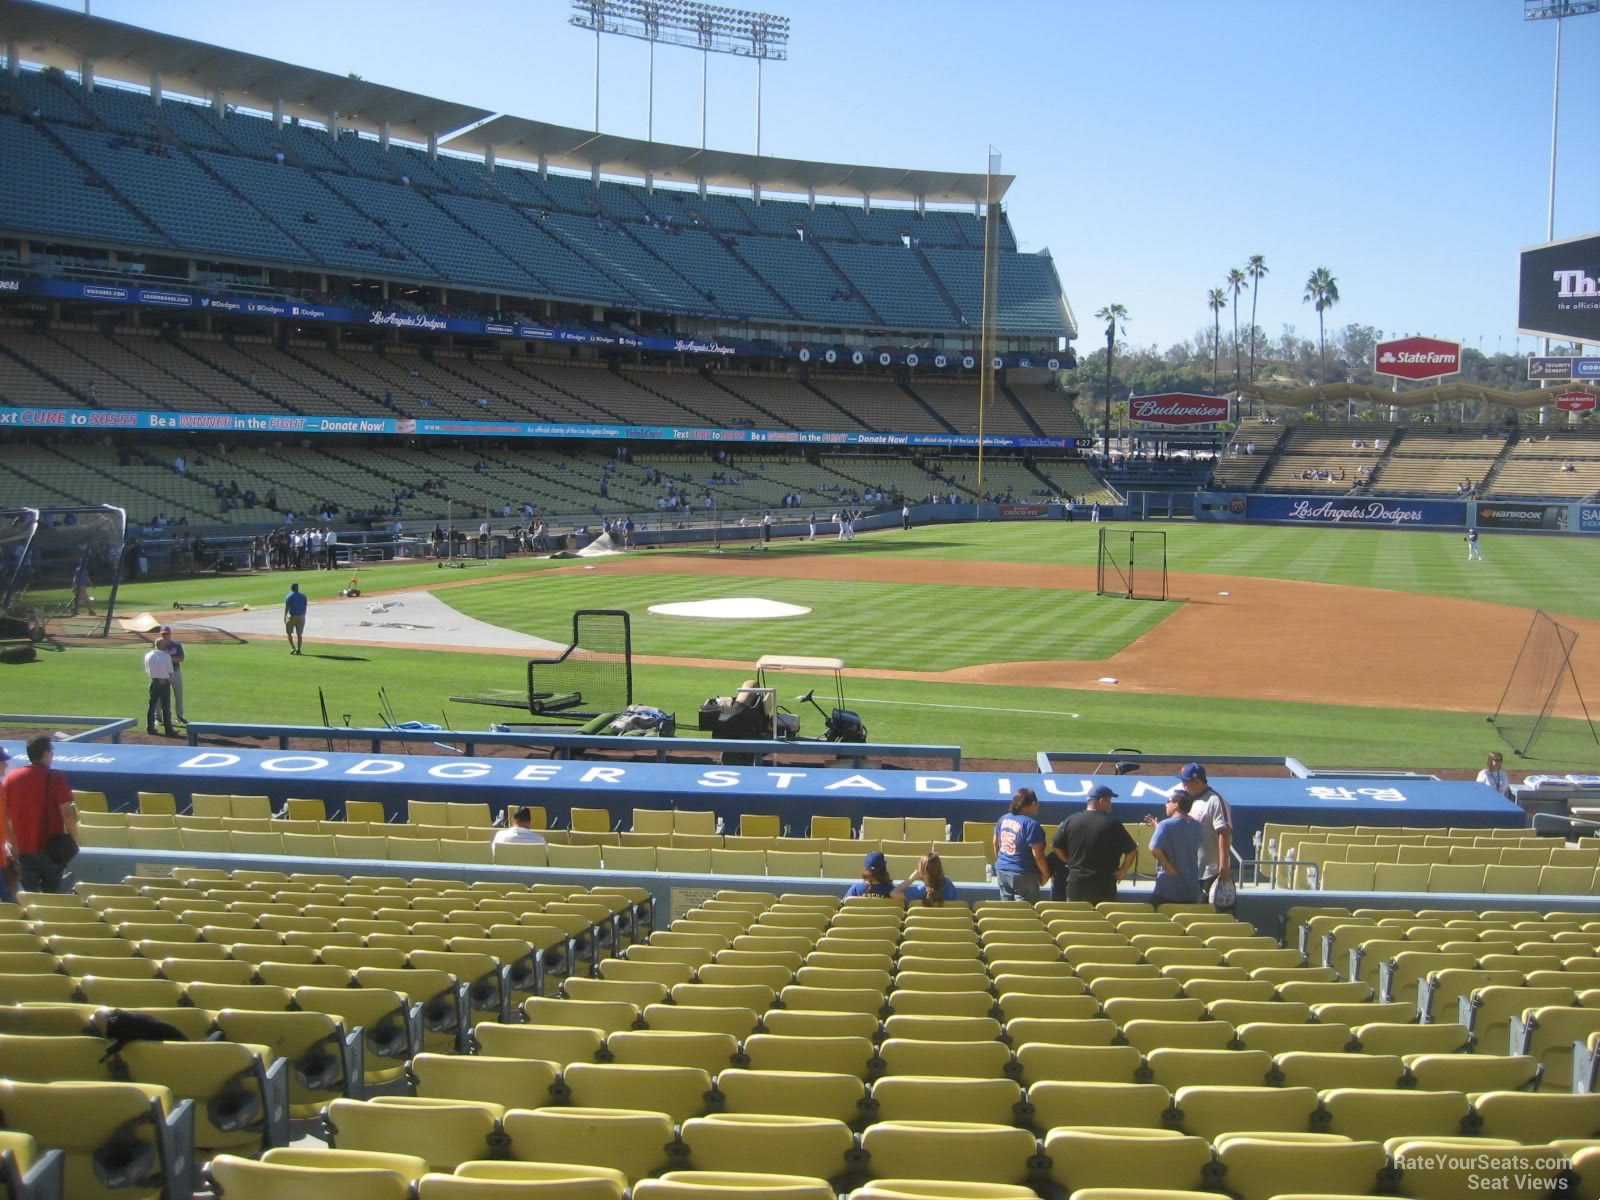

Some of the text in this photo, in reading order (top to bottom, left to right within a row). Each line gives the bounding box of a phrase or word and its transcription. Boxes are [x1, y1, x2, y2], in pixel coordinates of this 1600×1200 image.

[1553, 270, 1600, 298] Th
[211, 301, 240, 310] @Dodgers
[257, 305, 284, 314] @Dodgers
[369, 311, 447, 330] Los Angeles Dodgers
[674, 340, 735, 355] Los Angeles Dodgers
[1133, 400, 1226, 416] Budweiser
[22, 411, 65, 424] CURE
[71, 413, 87, 425] to
[90, 413, 137, 426] 50555
[150, 415, 166, 426] Be
[169, 417, 176, 427] a
[180, 415, 232, 427] WINNER
[234, 416, 245, 428] in
[248, 417, 266, 429] the
[269, 417, 306, 430] FIGHT
[321, 420, 358, 431] Donate
[360, 420, 385, 431] Now!
[673, 430, 689, 439] Text
[712, 431, 720, 440] to
[751, 432, 760, 440] Be
[800, 433, 807, 441] in
[808, 433, 821, 442] the
[858, 434, 887, 443] Donate
[888, 435, 908, 444] Now!
[1289, 501, 1422, 524] Los Angeles Dodgers
[1582, 510, 1600, 520] SA
[177, 752, 1185, 797] DODGER STADIUM
